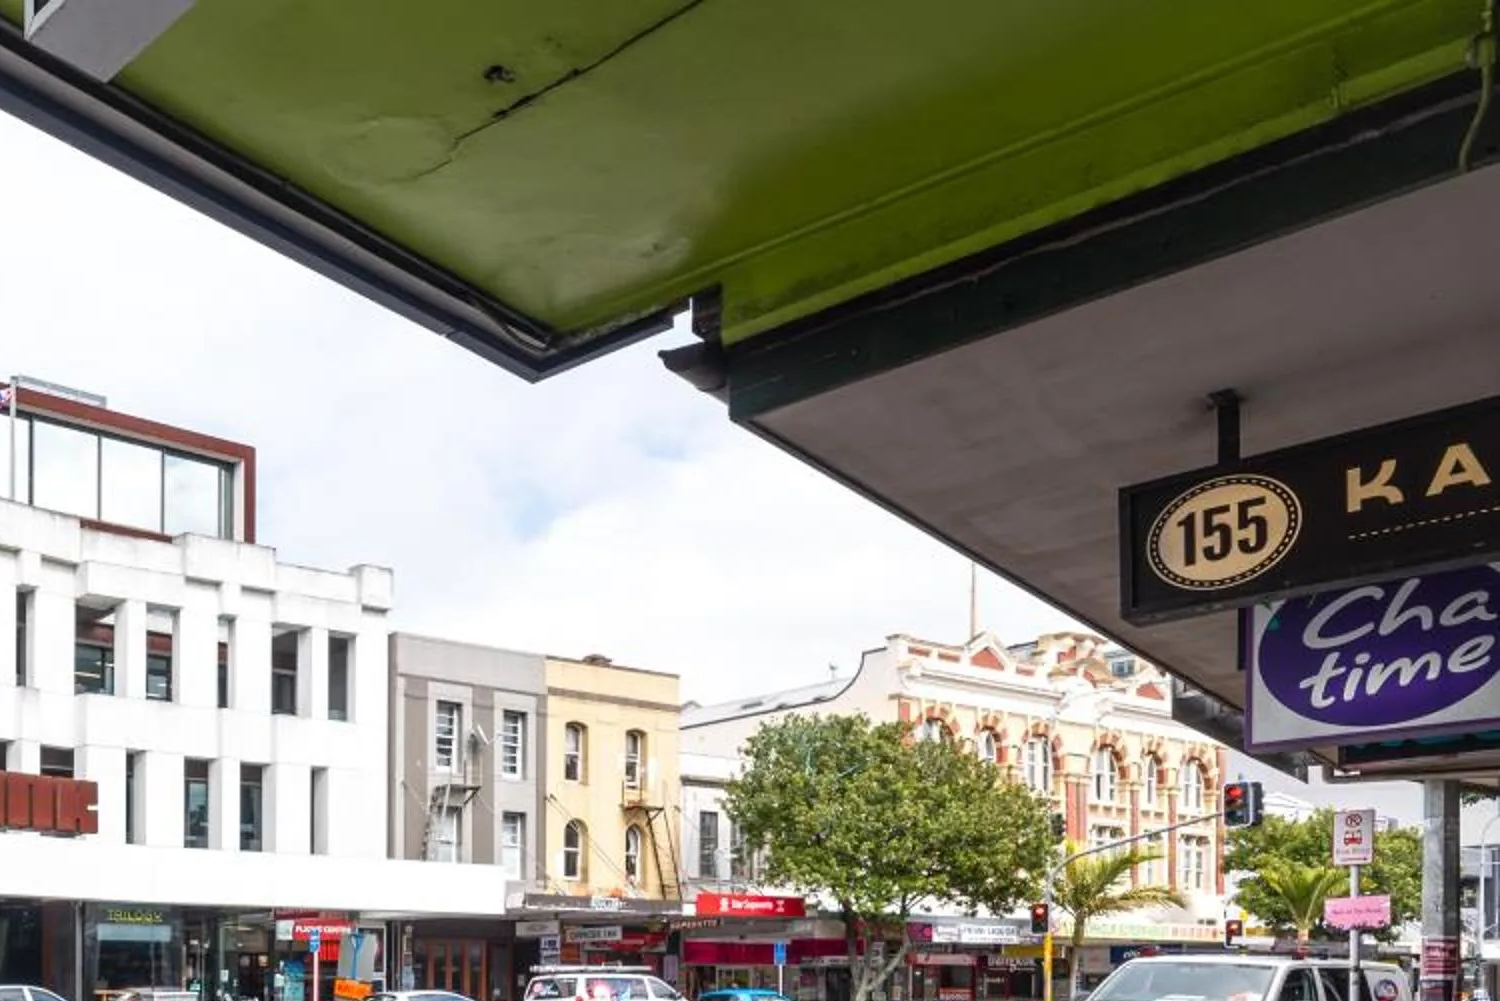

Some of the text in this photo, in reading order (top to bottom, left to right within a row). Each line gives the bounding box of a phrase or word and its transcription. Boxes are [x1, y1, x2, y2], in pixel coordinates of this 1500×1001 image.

[1176, 496, 1269, 567] 155
[1302, 577, 1499, 650] Cha
[1299, 634, 1496, 710] time
